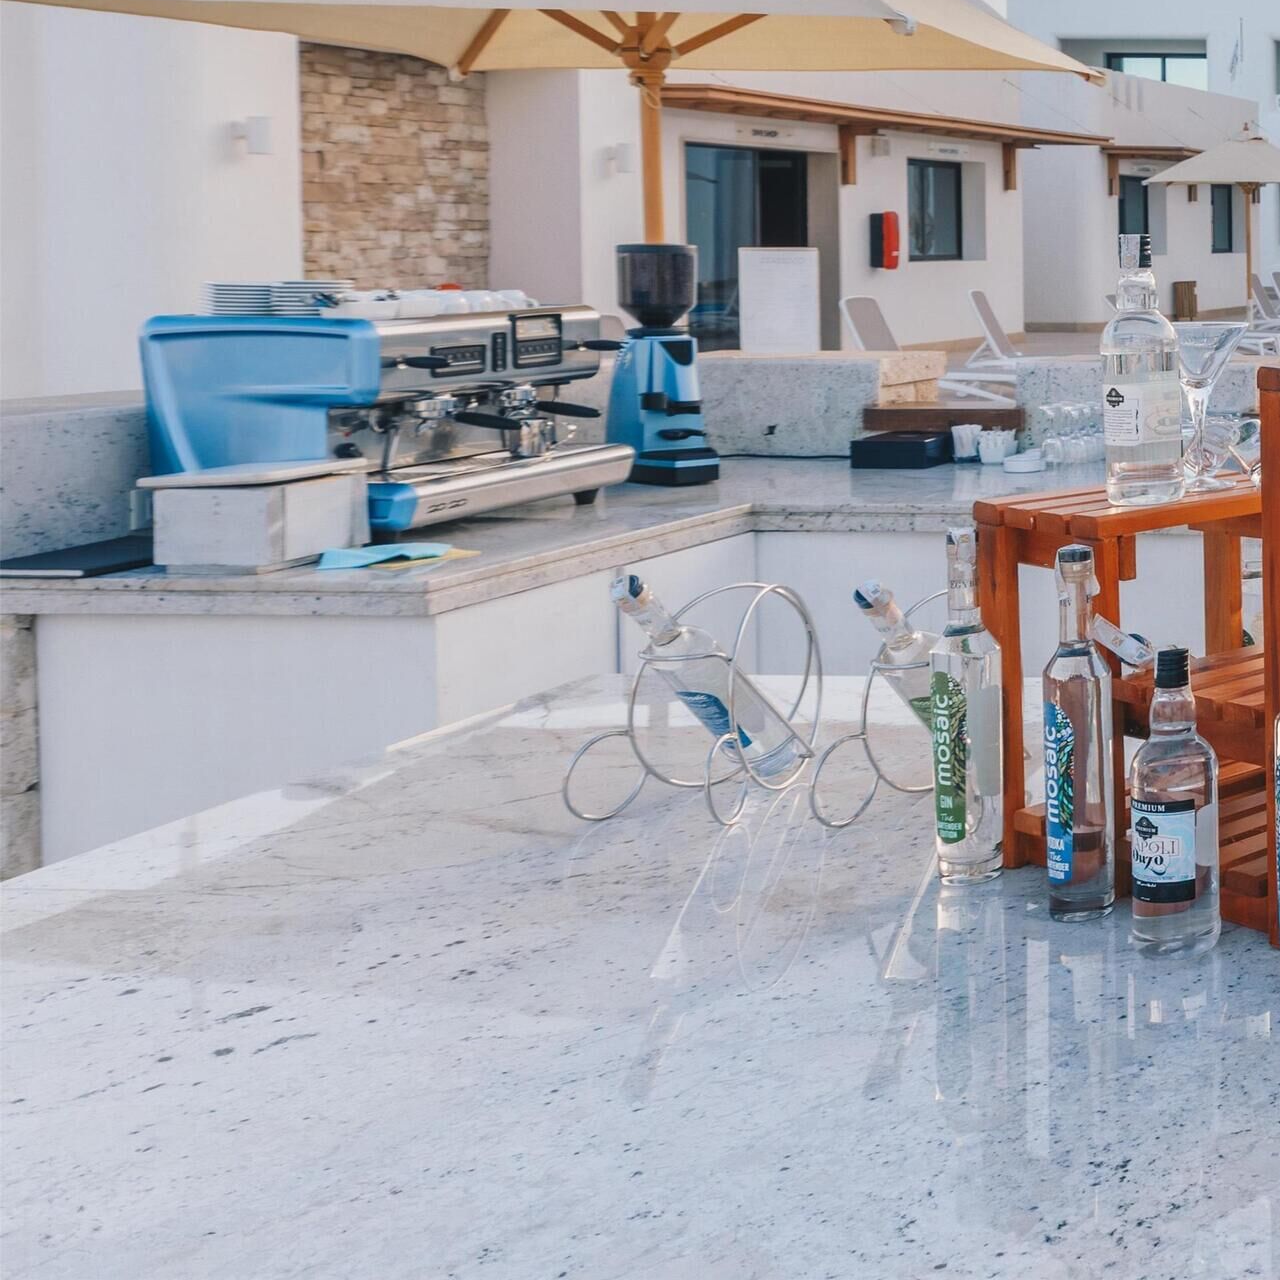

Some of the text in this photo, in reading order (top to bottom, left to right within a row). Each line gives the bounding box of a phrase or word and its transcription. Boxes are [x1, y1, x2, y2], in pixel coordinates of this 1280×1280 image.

[937, 693, 949, 786] mosaic
[1046, 725, 1058, 822] mosaic
[940, 795, 953, 809] GIN
